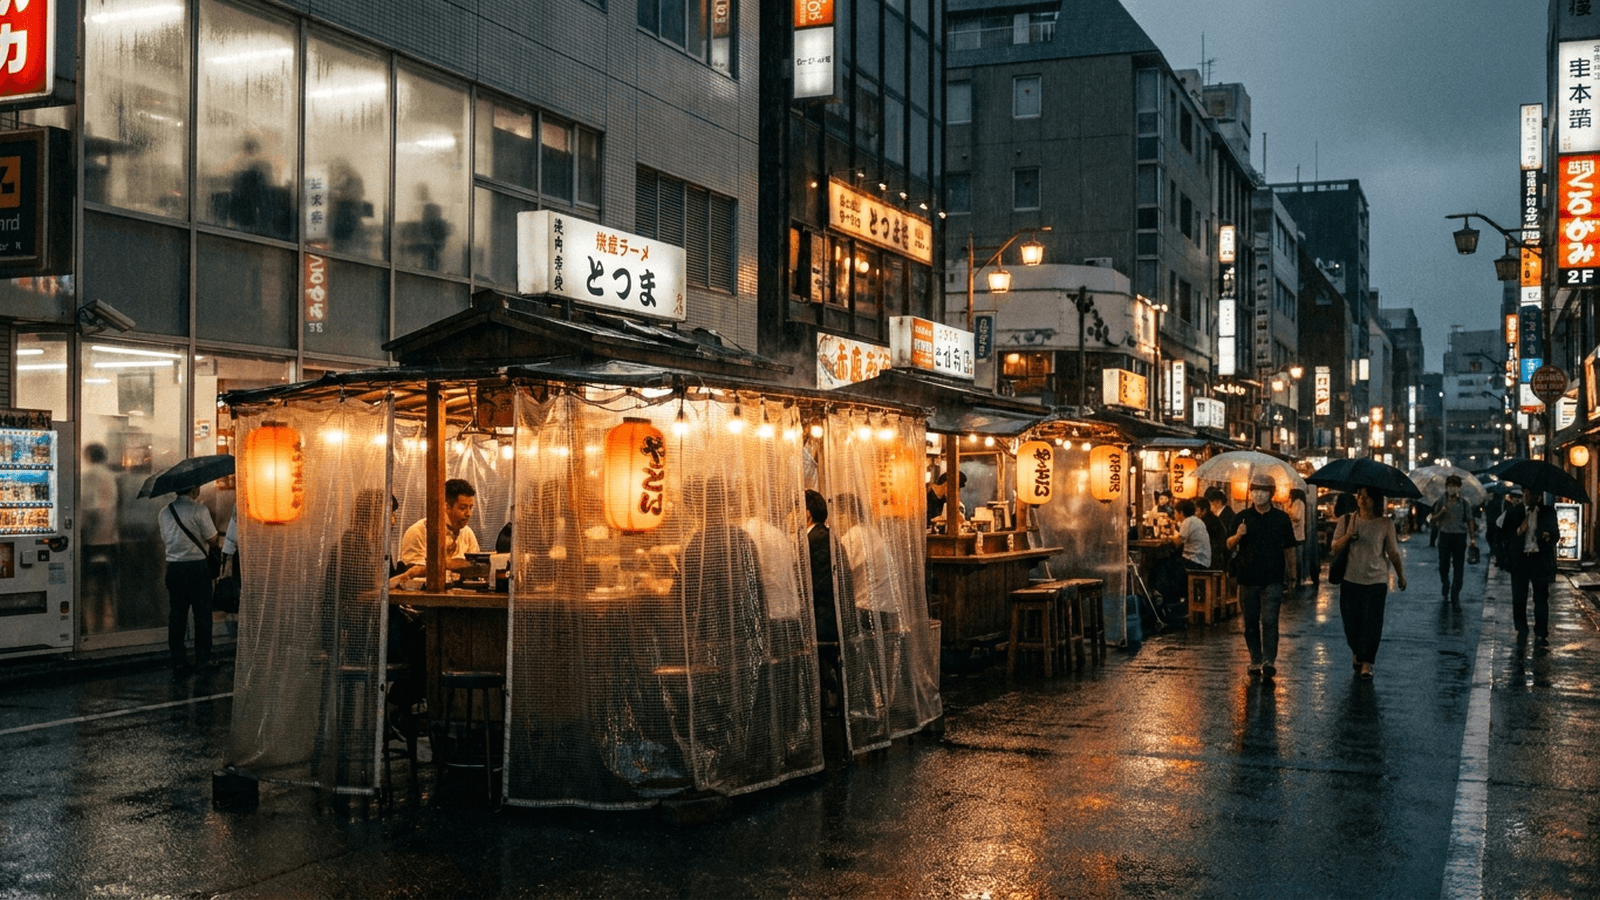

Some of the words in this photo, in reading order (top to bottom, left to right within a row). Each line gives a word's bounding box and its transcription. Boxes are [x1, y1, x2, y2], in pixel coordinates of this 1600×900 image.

[586, 255, 657, 308] とつま
[1567, 269, 1594, 284] 2F
